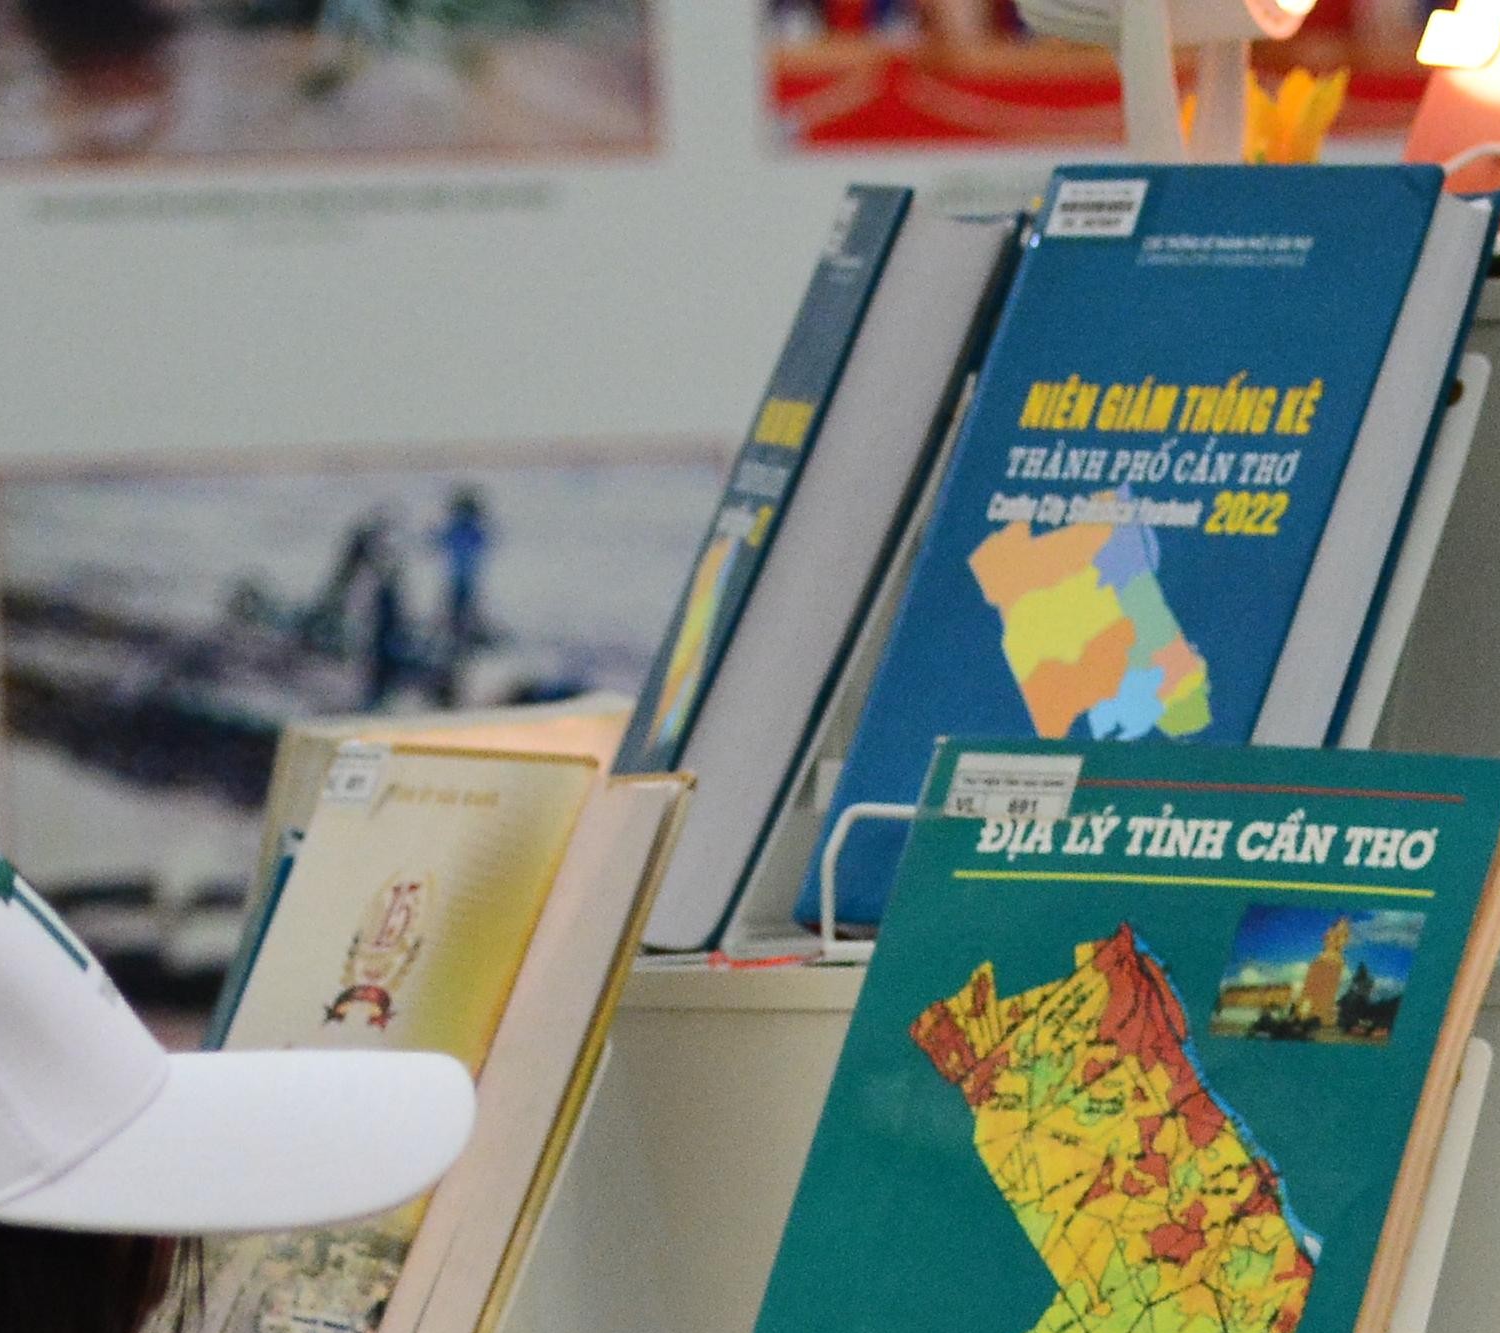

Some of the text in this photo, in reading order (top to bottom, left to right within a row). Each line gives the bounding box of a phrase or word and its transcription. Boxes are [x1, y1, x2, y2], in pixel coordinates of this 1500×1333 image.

[1006, 436, 1301, 484] THÀNH PHỐ CẦN THƠ
[1204, 492, 1290, 535] 2022
[977, 803, 1439, 870] ĐỊA LÝ TỈNH CẦN THƠ
